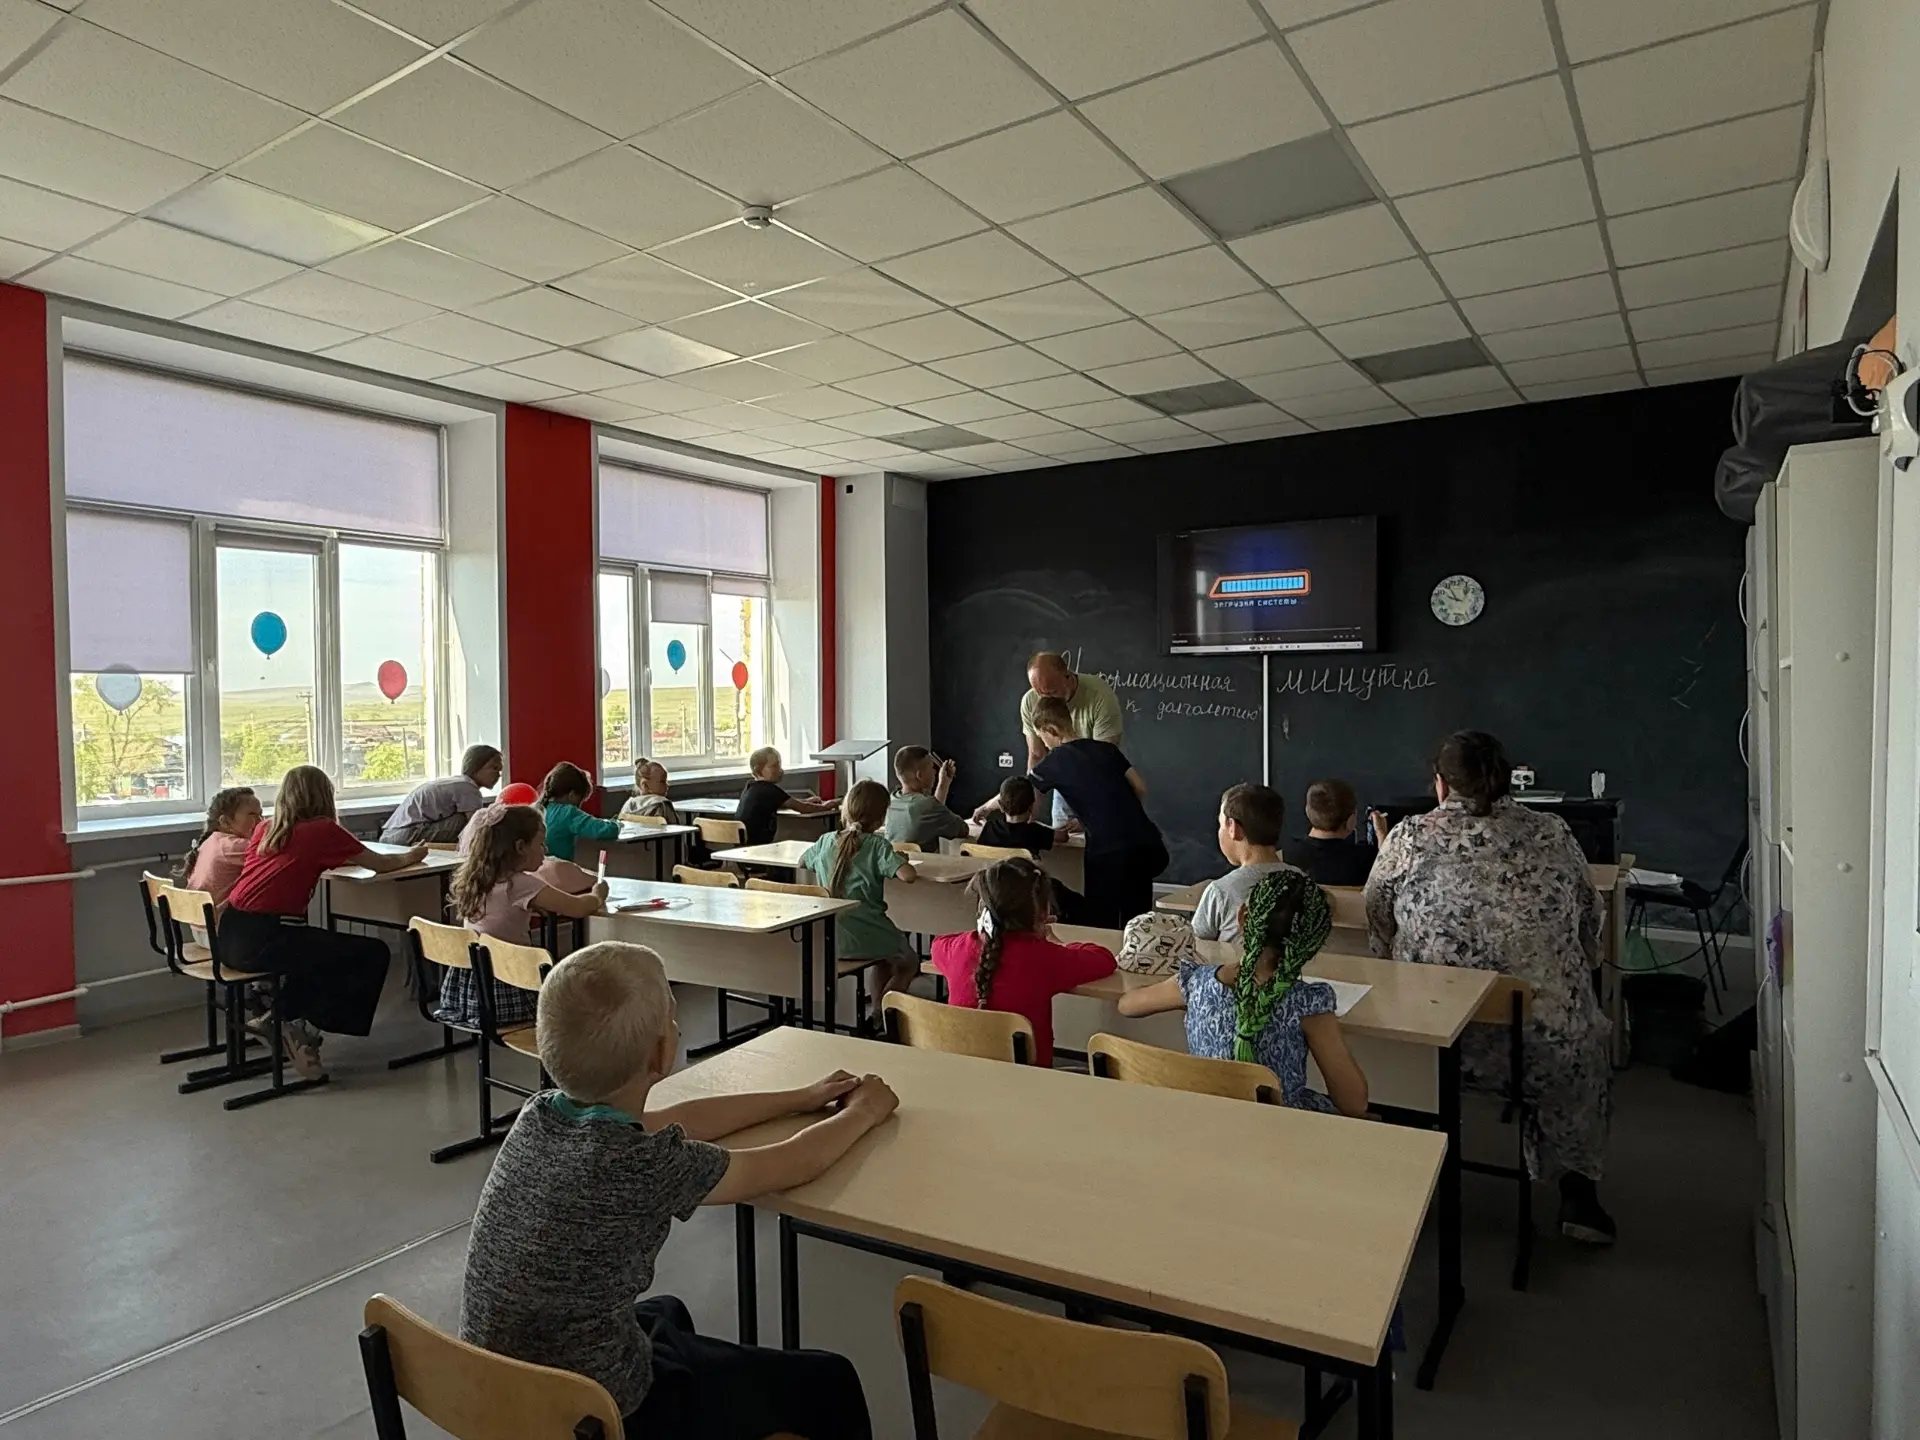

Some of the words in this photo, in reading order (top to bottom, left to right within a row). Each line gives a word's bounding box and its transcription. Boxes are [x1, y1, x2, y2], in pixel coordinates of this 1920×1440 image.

[1061, 646, 1236, 693] Иормационная
[1276, 664, 1437, 701] минутка
[1125, 699, 1143, 713] к
